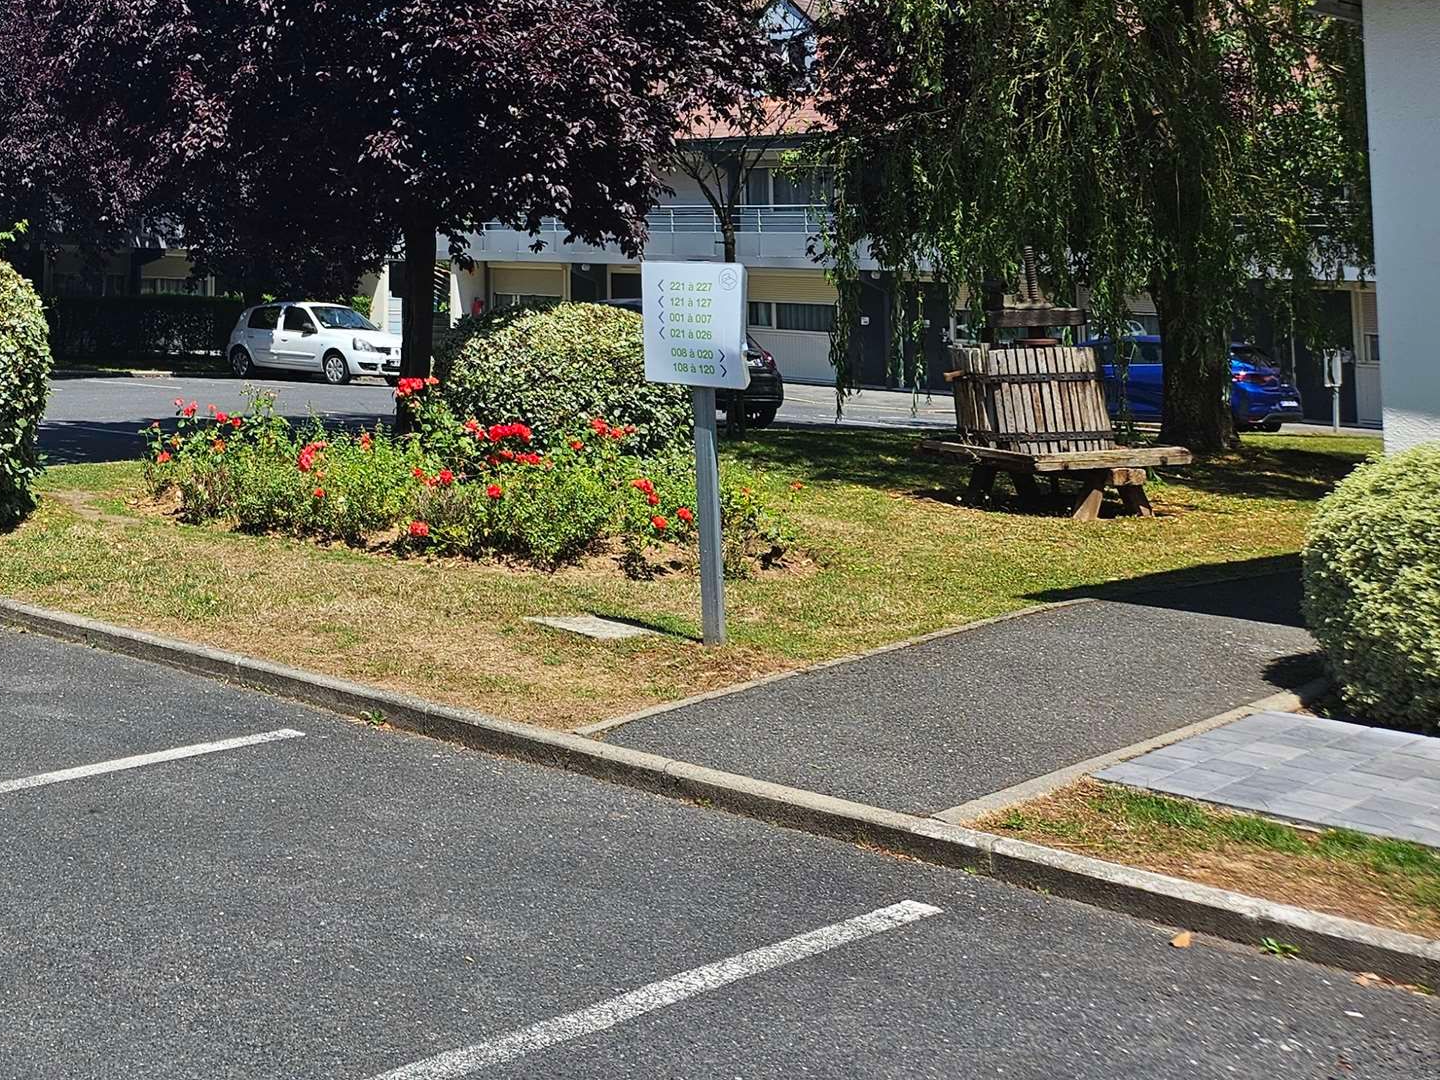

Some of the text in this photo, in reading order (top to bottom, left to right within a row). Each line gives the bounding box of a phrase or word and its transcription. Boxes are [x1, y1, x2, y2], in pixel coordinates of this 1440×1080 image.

[670, 281, 685, 291] 221
[696, 282, 712, 292] 227
[670, 297, 685, 307] 121
[696, 298, 712, 308] 127
[669, 312, 685, 322] 001
[695, 314, 712, 324] 007
[670, 328, 685, 338] 021
[696, 330, 712, 340] 026
[671, 348, 687, 358] 008
[697, 349, 714, 359] 020
[673, 362, 688, 372] 108
[699, 364, 715, 374] 120
